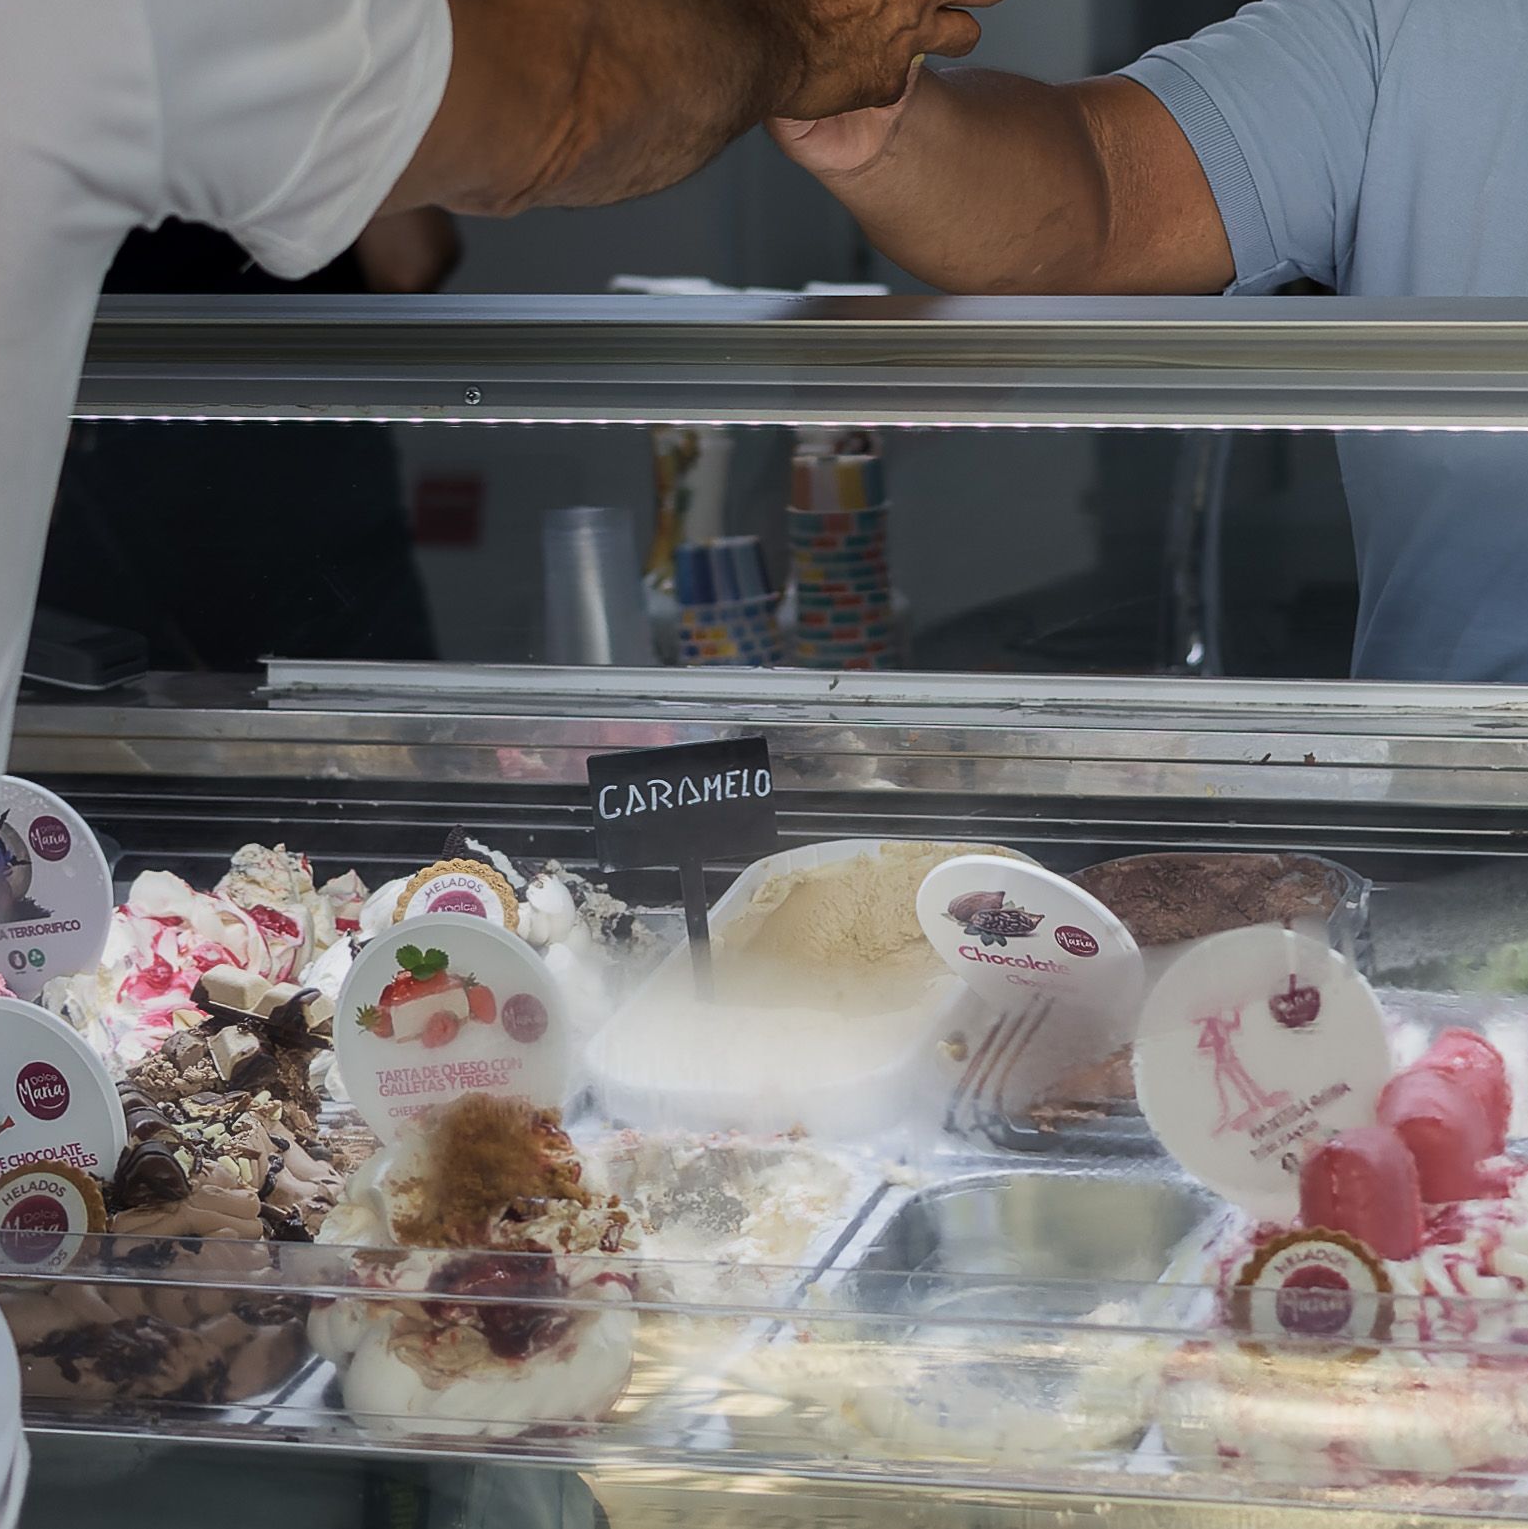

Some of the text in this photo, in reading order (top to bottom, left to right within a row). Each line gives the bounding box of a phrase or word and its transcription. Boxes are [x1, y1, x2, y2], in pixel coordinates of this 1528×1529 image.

[598, 768, 772, 820] CARAMELO
[424, 877, 484, 902] HELADOS
[958, 945, 1074, 975] Chocolate
[376, 1055, 523, 1085] TARTA DE QUESO CON
[379, 1072, 511, 1098] GALLETAS Y FRESAS
[7, 1142, 84, 1168] CHOCOLATE
[1, 1178, 68, 1207] HELADOS
